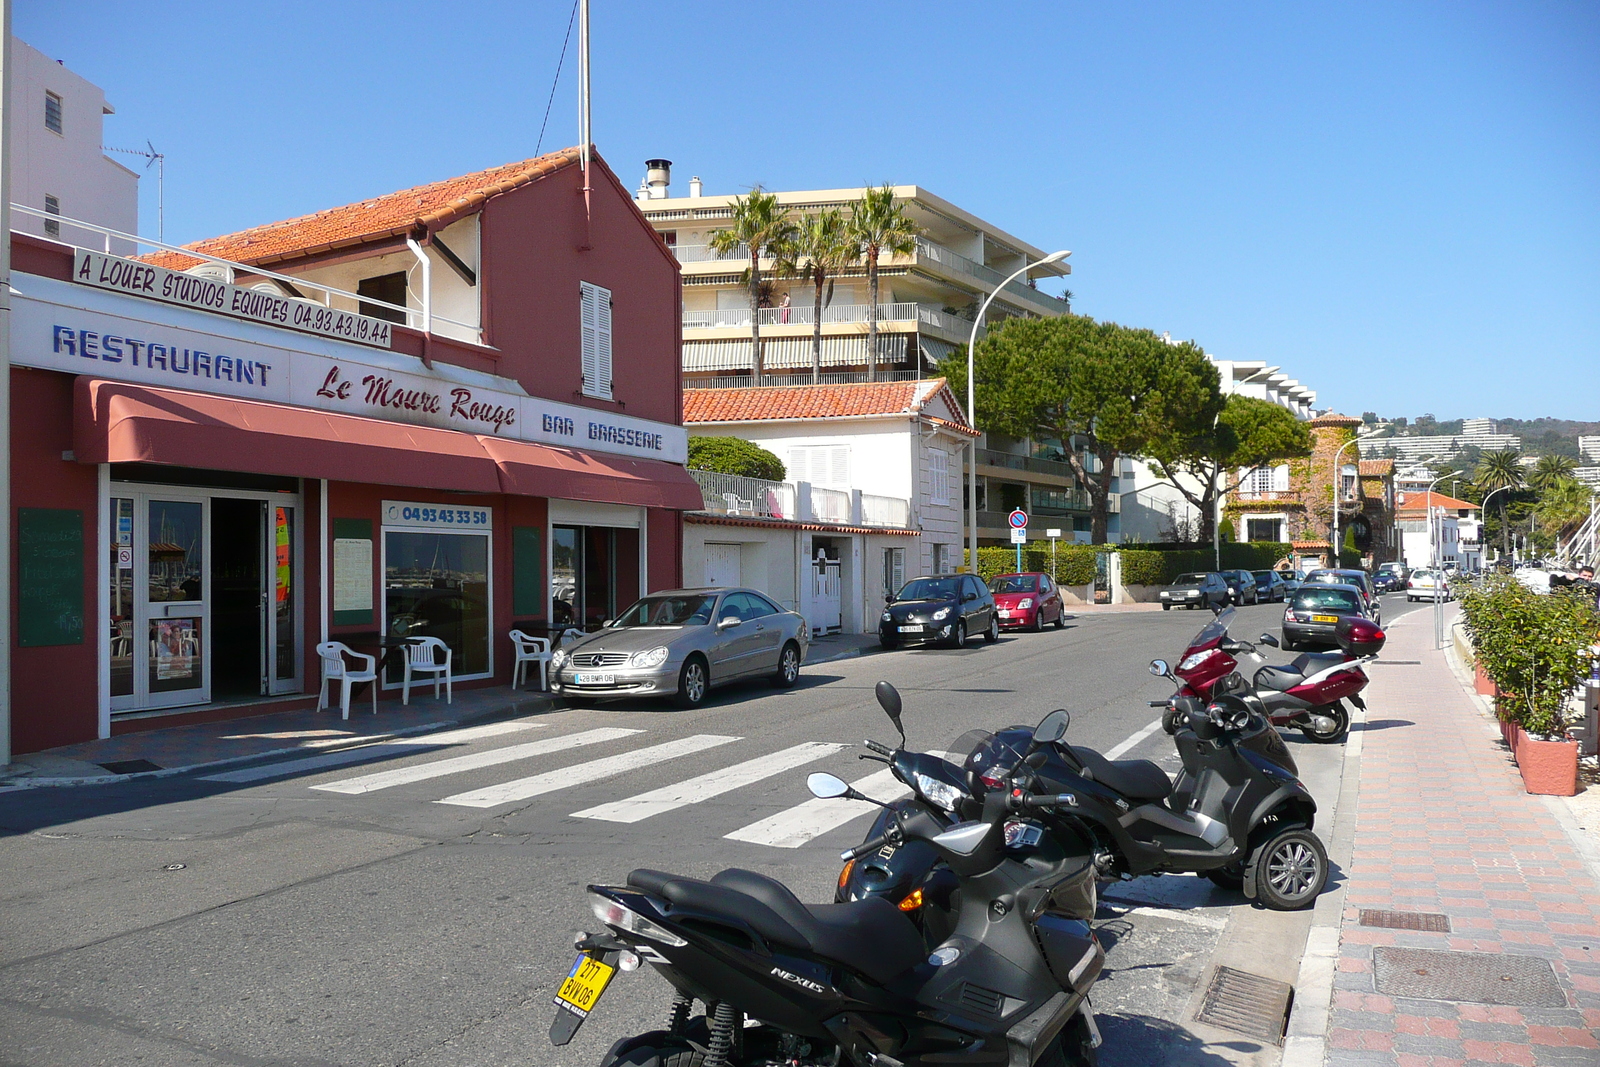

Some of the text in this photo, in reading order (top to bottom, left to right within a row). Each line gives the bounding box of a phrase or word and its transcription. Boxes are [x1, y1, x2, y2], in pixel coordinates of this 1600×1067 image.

[79, 254, 389, 343] A LOUER STUDIOS EQUIPES 04.93.43.19.44
[53, 324, 272, 387] RESTAURANT
[316, 365, 516, 434] Le Moure Rouge
[542, 413, 664, 450] BAR BRASSERIE
[579, 961, 601, 982] 277
[771, 967, 825, 993] NEXUS
[577, 986, 594, 1006] 06
